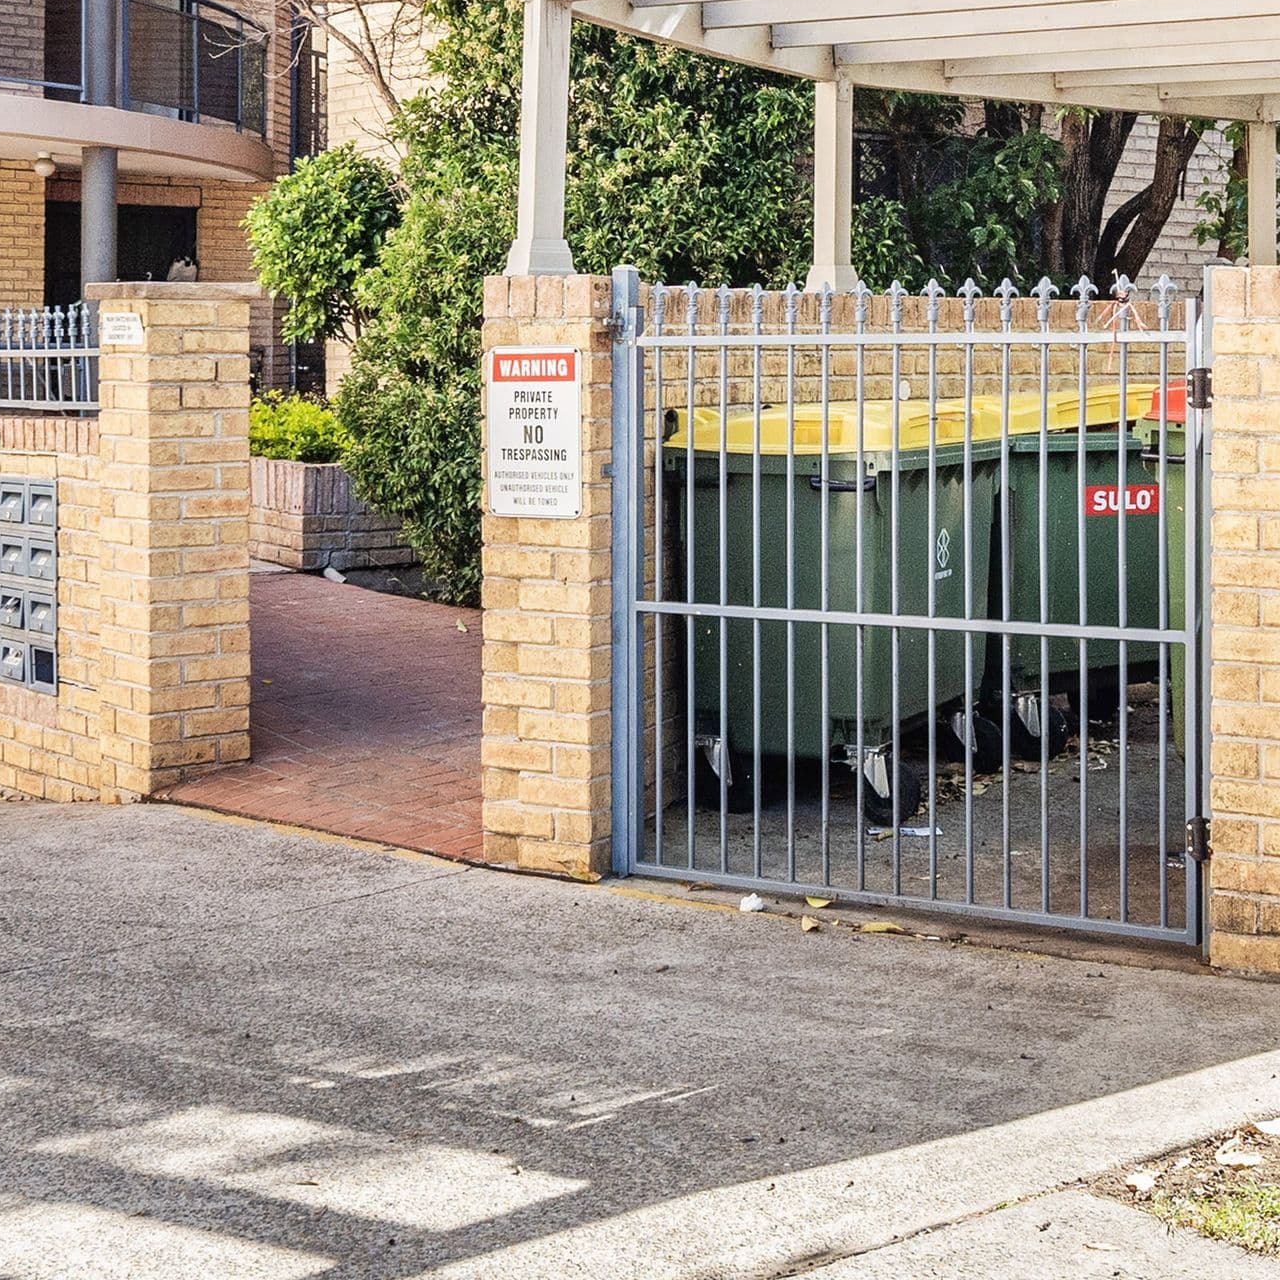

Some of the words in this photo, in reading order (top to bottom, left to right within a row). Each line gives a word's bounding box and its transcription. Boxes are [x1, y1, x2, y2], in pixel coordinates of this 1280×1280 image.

[499, 359, 568, 377] WARNING
[514, 391, 553, 403] PRIVATE
[509, 407, 559, 420] PROPERTY
[523, 425, 544, 444] NO
[501, 448, 567, 461] TRESPASSING
